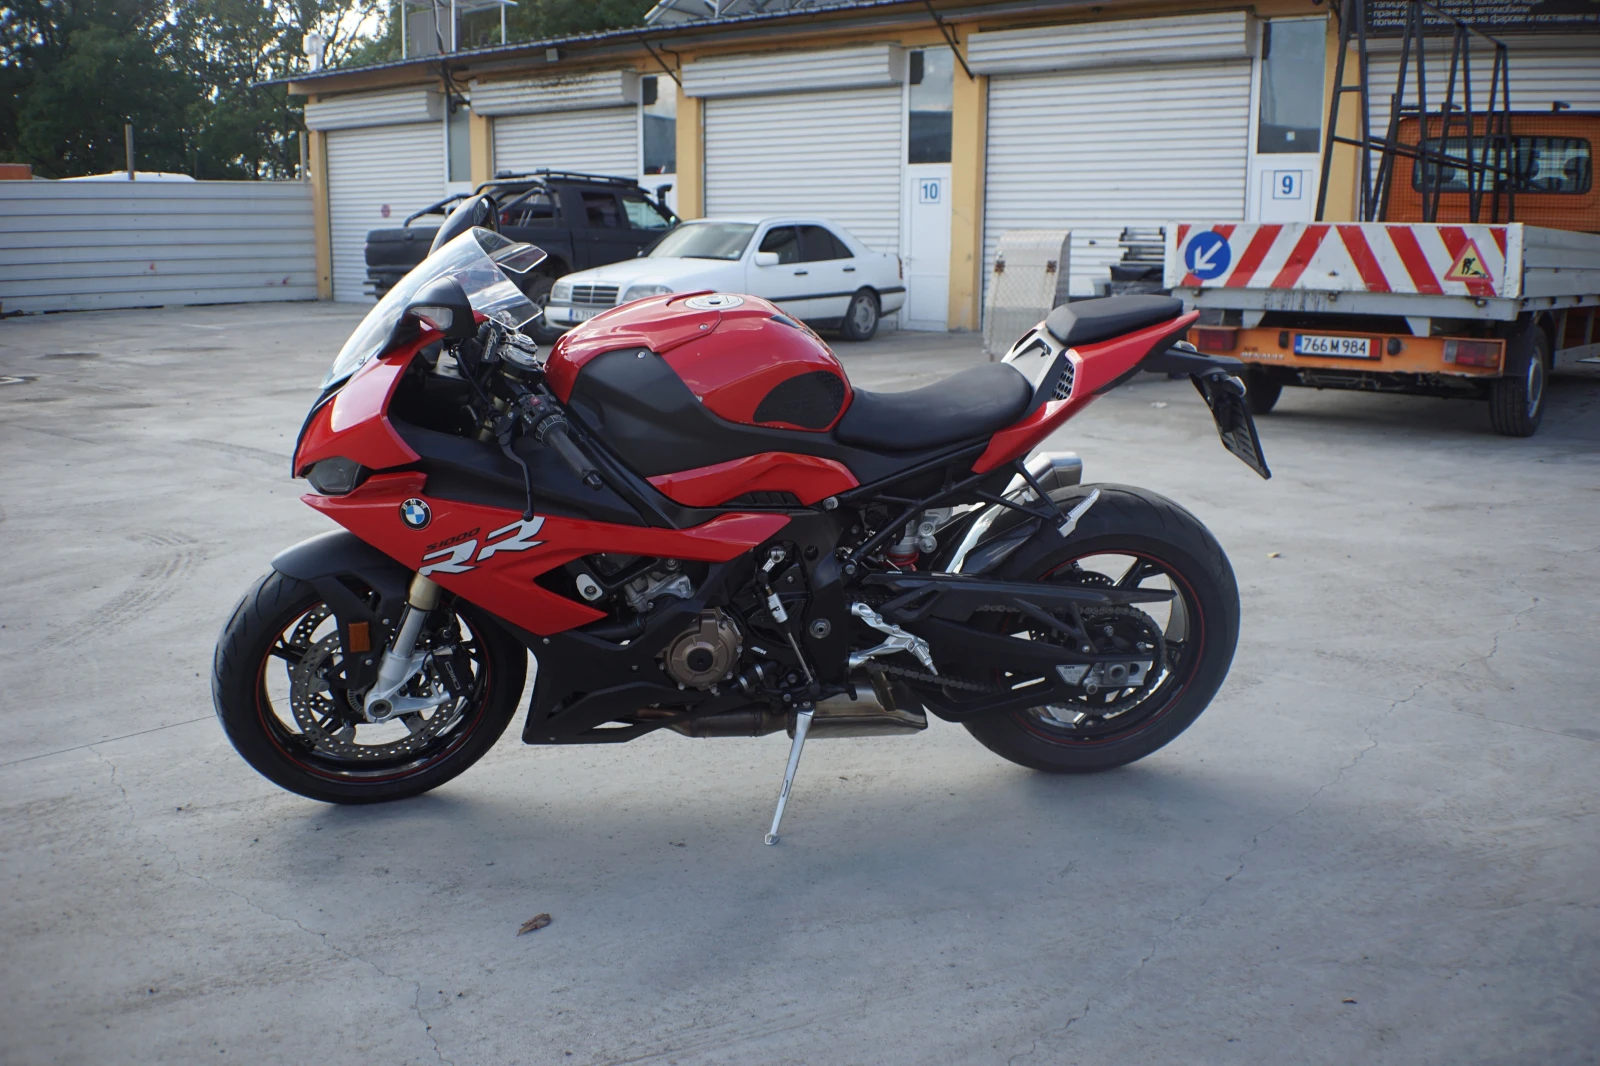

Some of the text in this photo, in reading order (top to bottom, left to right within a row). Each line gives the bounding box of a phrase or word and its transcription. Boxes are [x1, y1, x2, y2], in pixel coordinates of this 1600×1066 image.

[923, 183, 938, 199] 10
[1282, 175, 1293, 194] 9
[1304, 337, 1367, 354] 766 M 984
